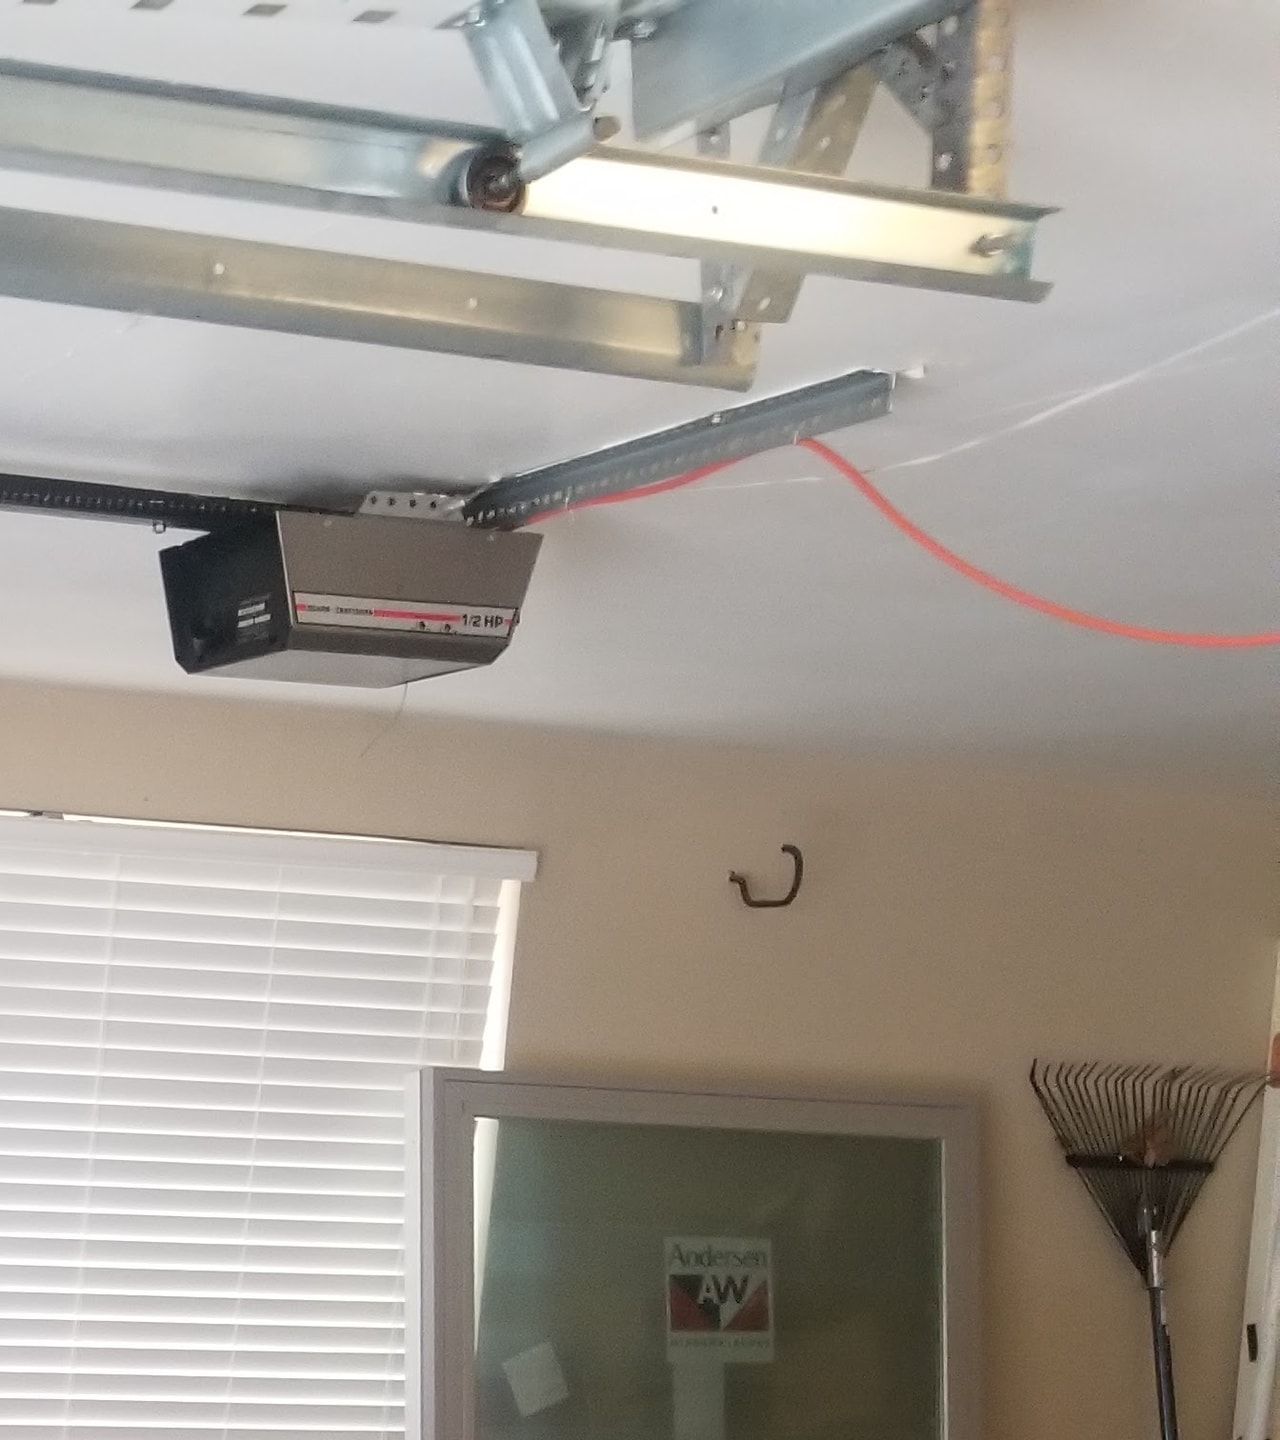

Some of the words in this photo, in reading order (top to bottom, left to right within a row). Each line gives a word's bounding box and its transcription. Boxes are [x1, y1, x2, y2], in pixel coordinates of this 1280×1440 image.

[462, 613, 481, 628] 1/2
[484, 615, 504, 629] HP
[670, 1243, 768, 1268] Andersen
[697, 1274, 750, 1305] AW
